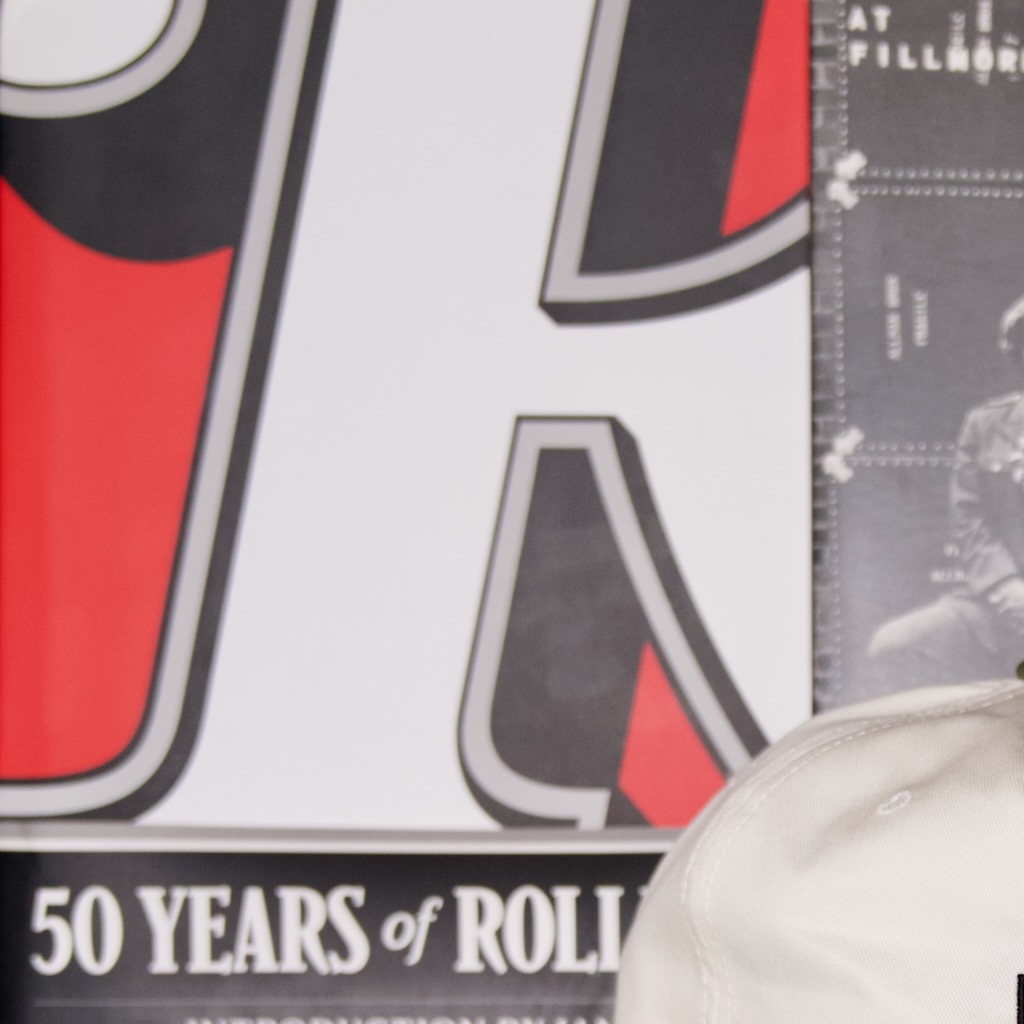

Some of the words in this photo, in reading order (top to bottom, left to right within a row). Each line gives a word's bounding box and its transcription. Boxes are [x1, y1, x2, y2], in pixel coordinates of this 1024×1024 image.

[848, 5, 892, 32] AT
[29, 885, 124, 976] 50
[135, 885, 371, 976] YEARS
[381, 896, 443, 967] of
[453, 885, 649, 976] ROLL
